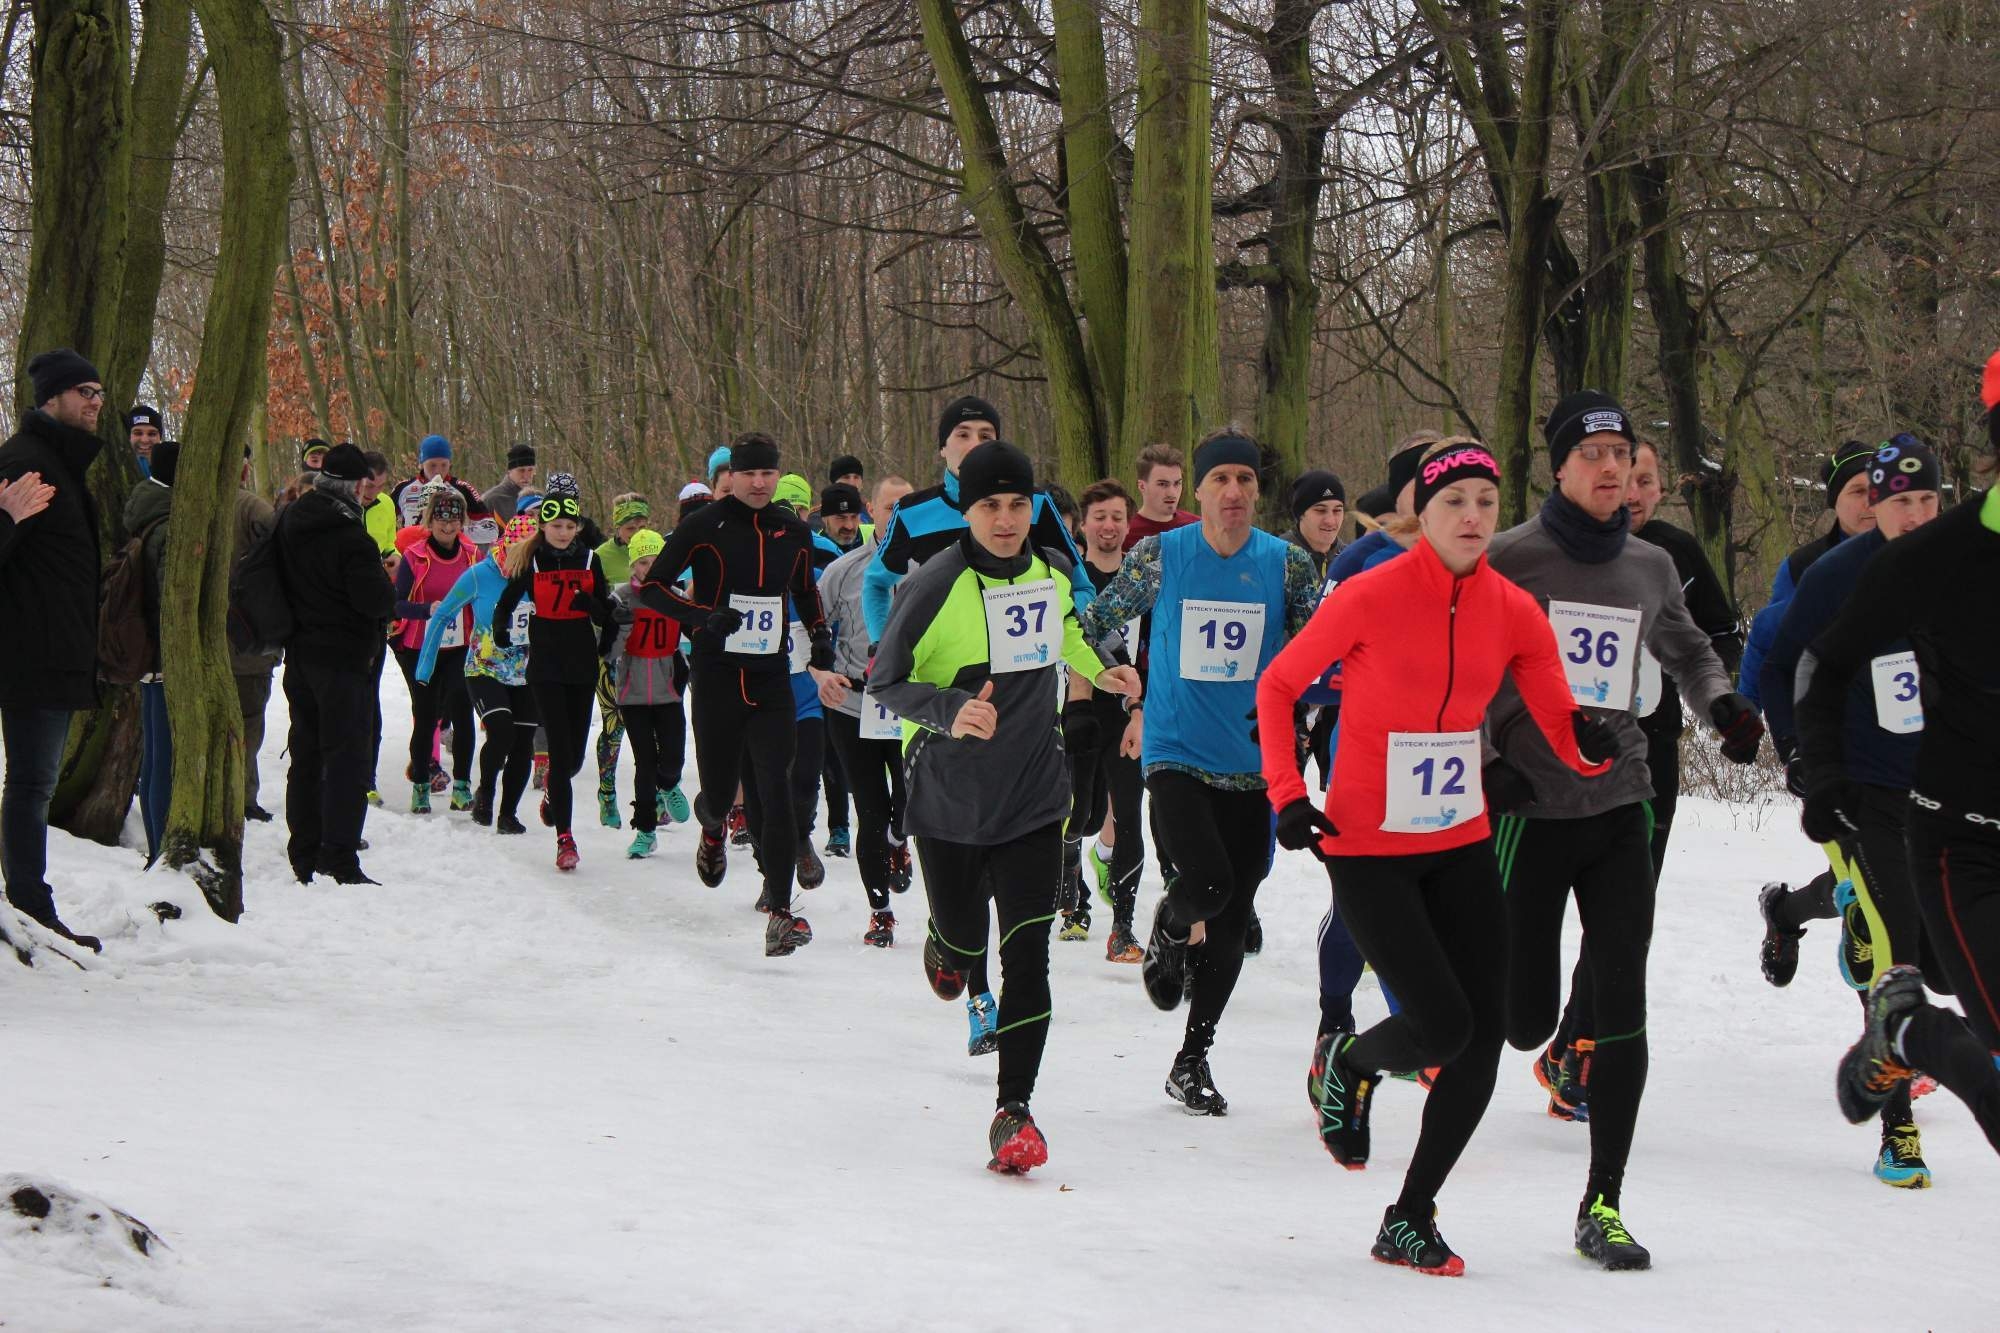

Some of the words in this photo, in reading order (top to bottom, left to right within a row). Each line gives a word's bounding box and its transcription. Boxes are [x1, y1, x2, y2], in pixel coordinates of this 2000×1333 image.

[639, 618, 667, 650] 70
[743, 610, 773, 631] 18
[1005, 601, 1047, 637] 37
[1199, 620, 1246, 650] 19
[1567, 627, 1619, 667] 36
[1413, 757, 1465, 795] 12
